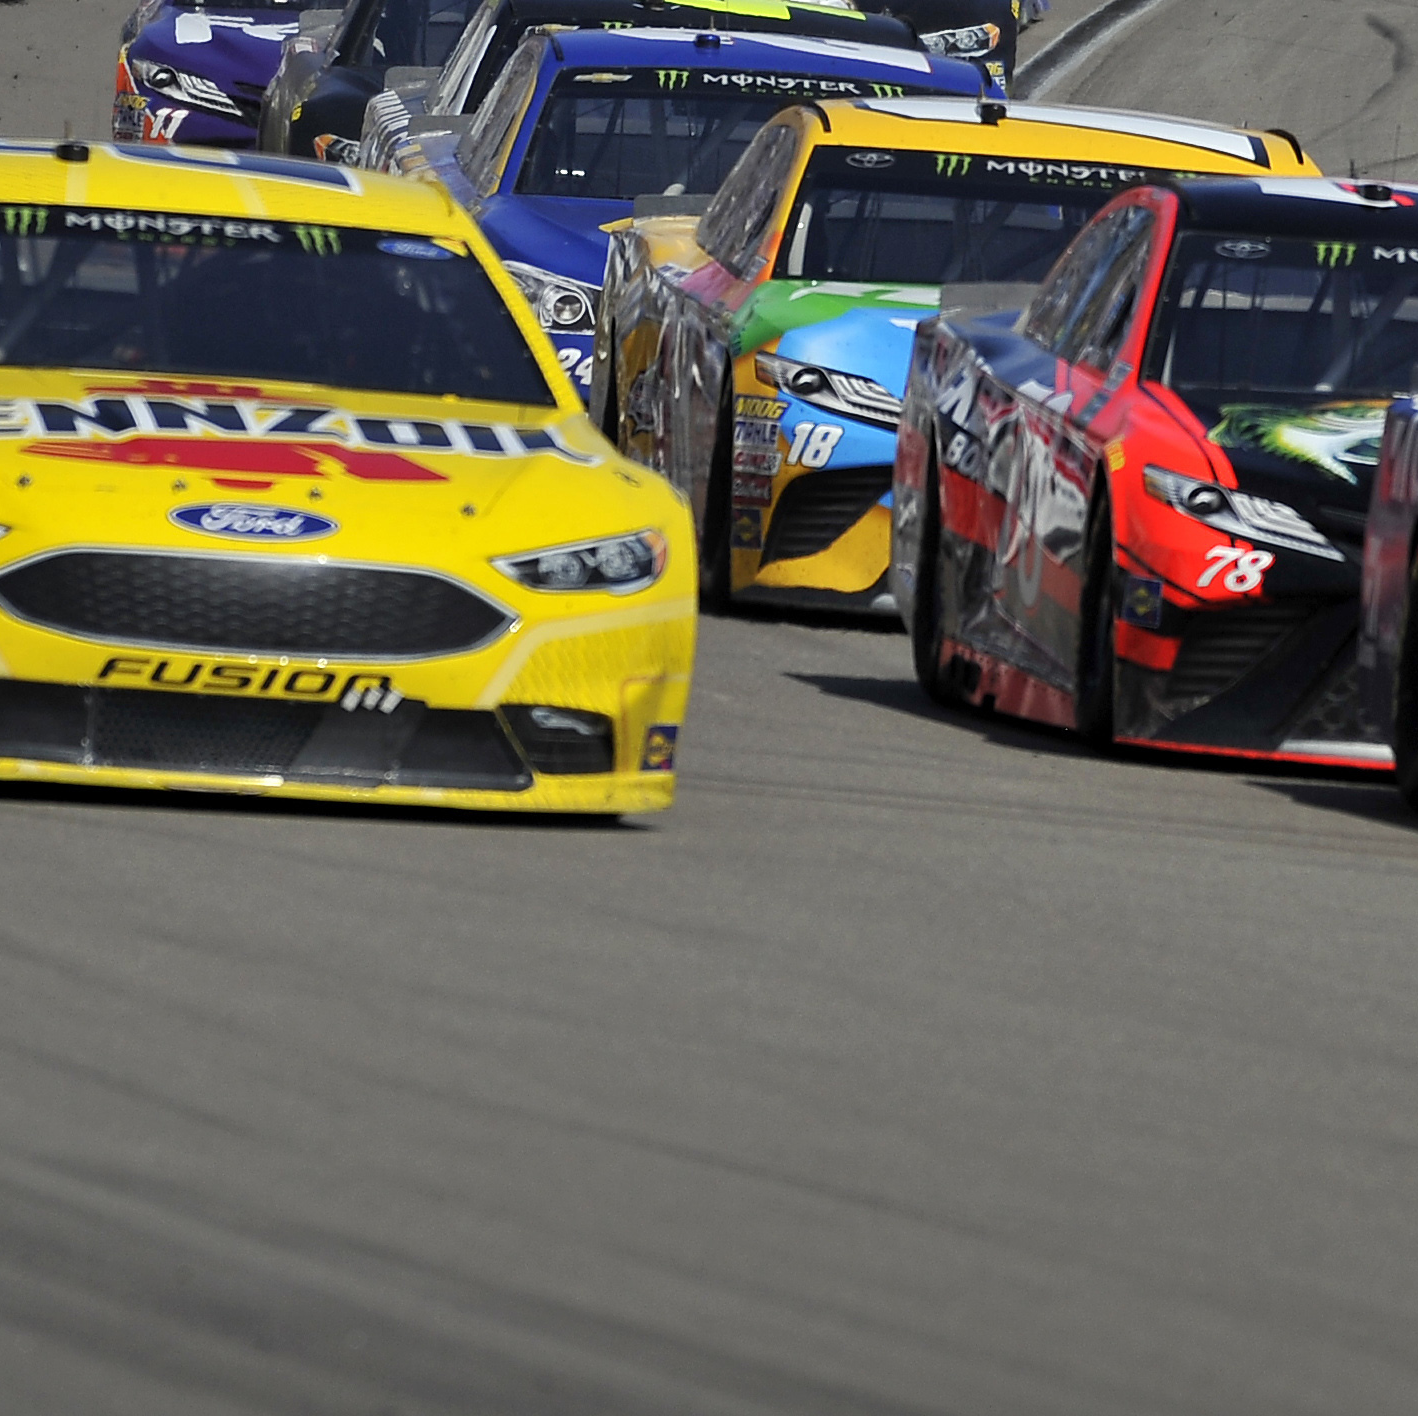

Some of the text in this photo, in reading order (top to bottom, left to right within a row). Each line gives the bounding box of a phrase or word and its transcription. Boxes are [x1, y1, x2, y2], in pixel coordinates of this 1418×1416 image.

[702, 72, 862, 96] MONSTER
[149, 107, 190, 139] 11
[65, 210, 281, 243] MONSTER
[735, 396, 789, 419] MOOG
[785, 420, 845, 469] 18
[198, 503, 307, 538] Ford
[1194, 545, 1276, 592] 78
[97, 656, 393, 698] FUSION
